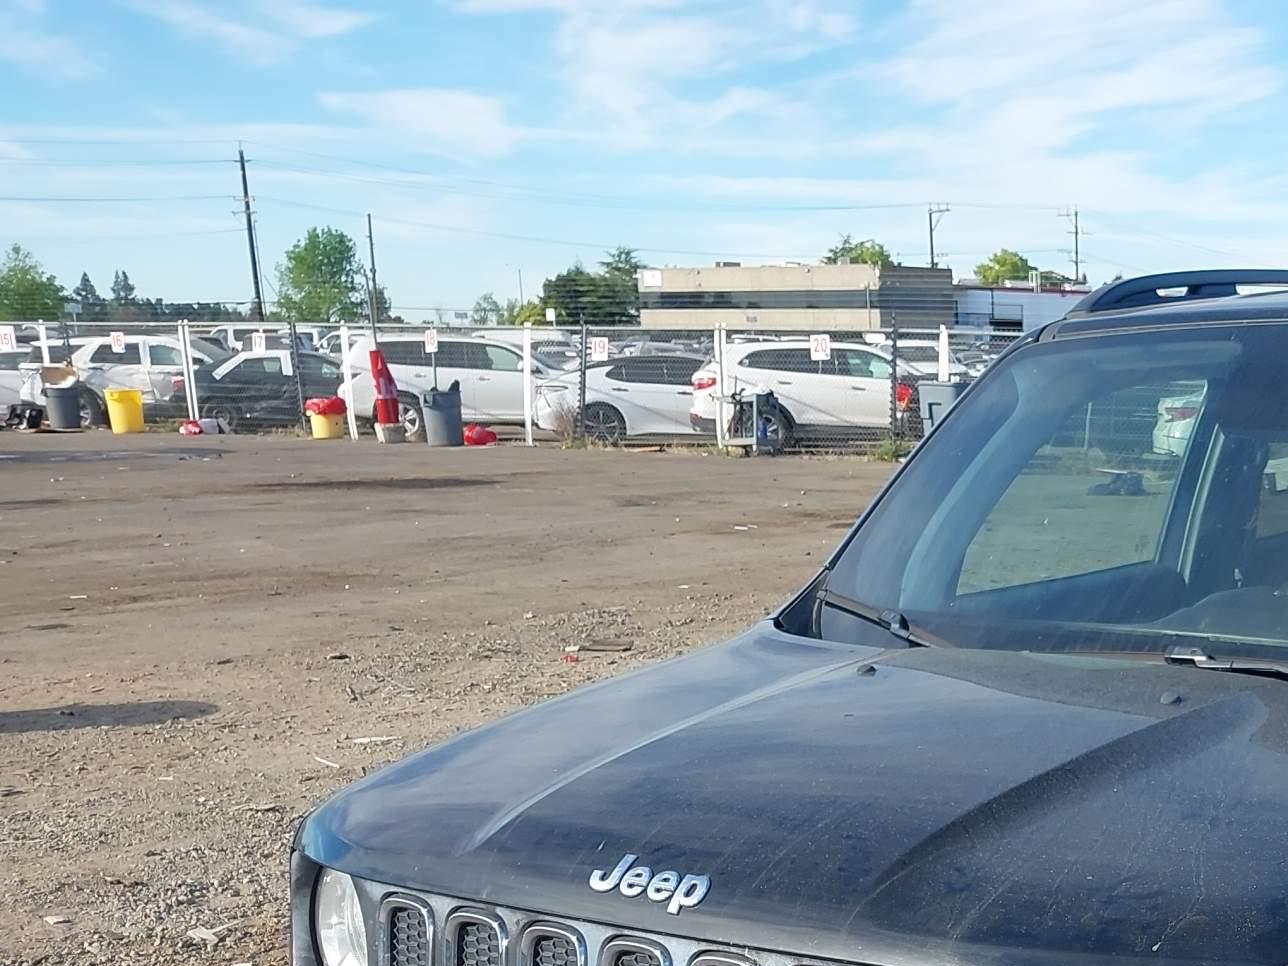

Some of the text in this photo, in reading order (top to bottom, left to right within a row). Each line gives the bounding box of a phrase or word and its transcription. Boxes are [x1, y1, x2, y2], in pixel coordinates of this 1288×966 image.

[253, 335, 263, 347] 17
[594, 340, 606, 353] 19
[814, 338, 827, 352] 20
[589, 853, 711, 915] Jeep
